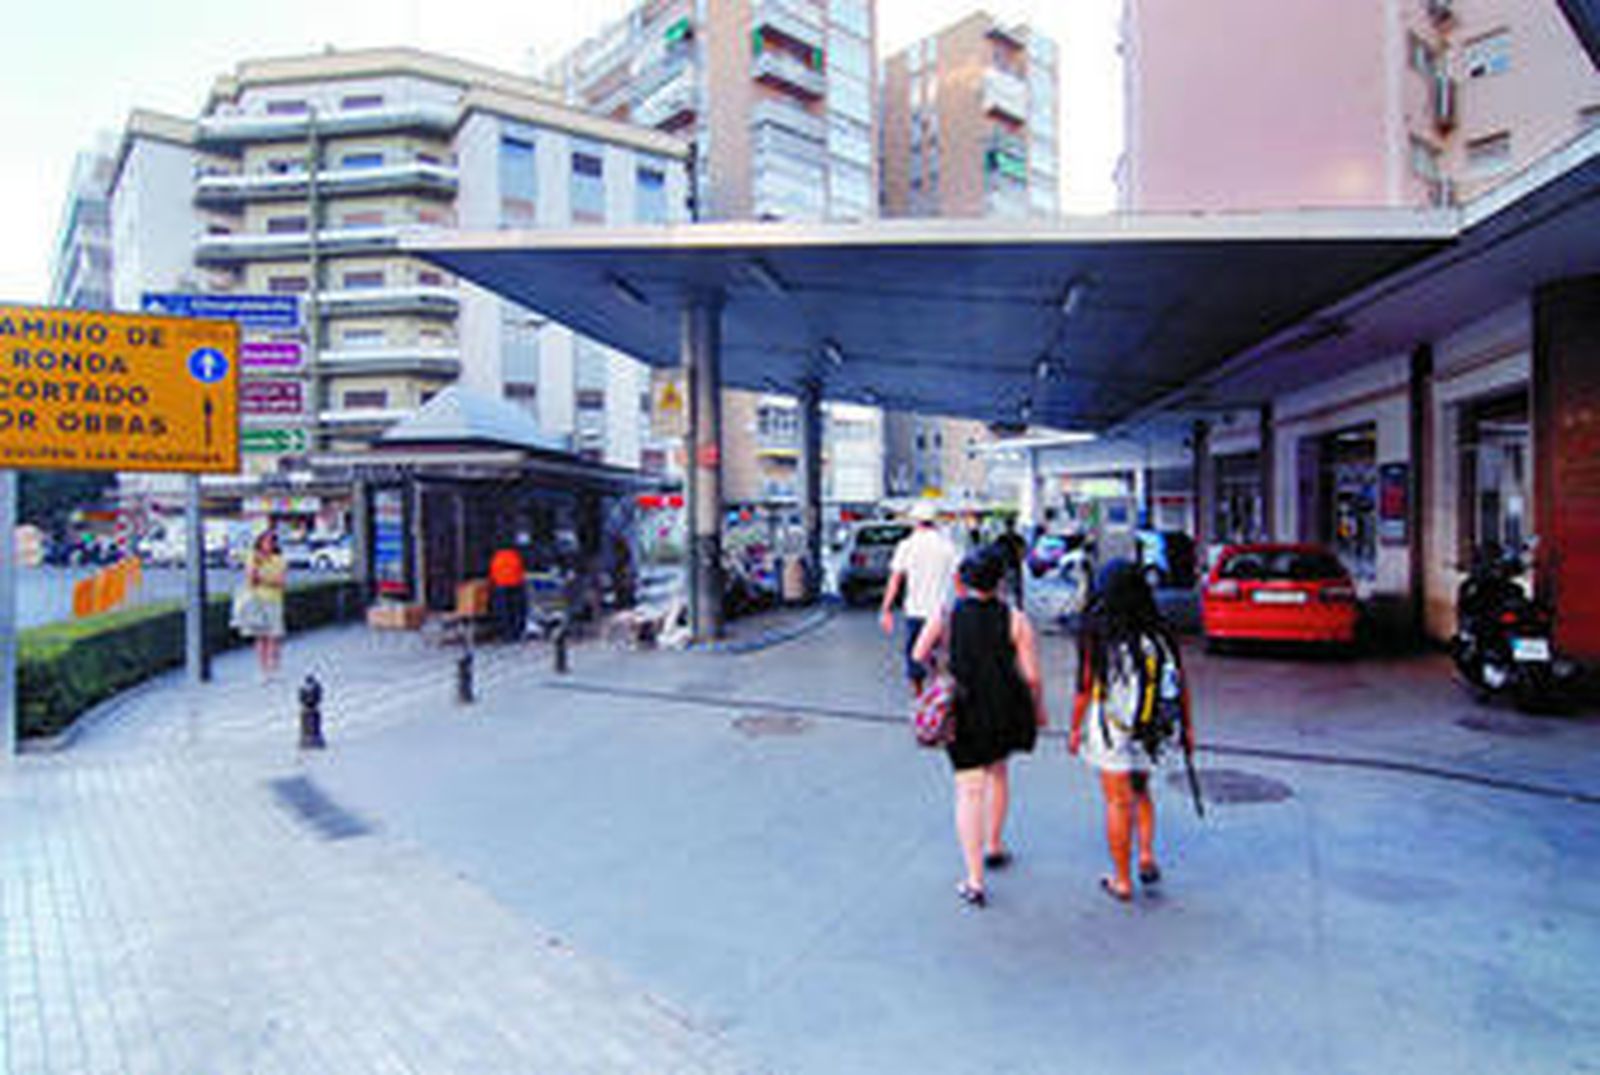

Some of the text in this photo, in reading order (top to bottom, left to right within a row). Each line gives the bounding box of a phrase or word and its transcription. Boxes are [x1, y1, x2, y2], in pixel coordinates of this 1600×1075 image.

[127, 327, 164, 347] DE
[14, 348, 128, 374] RONDA
[57, 411, 167, 435] OBRAS
